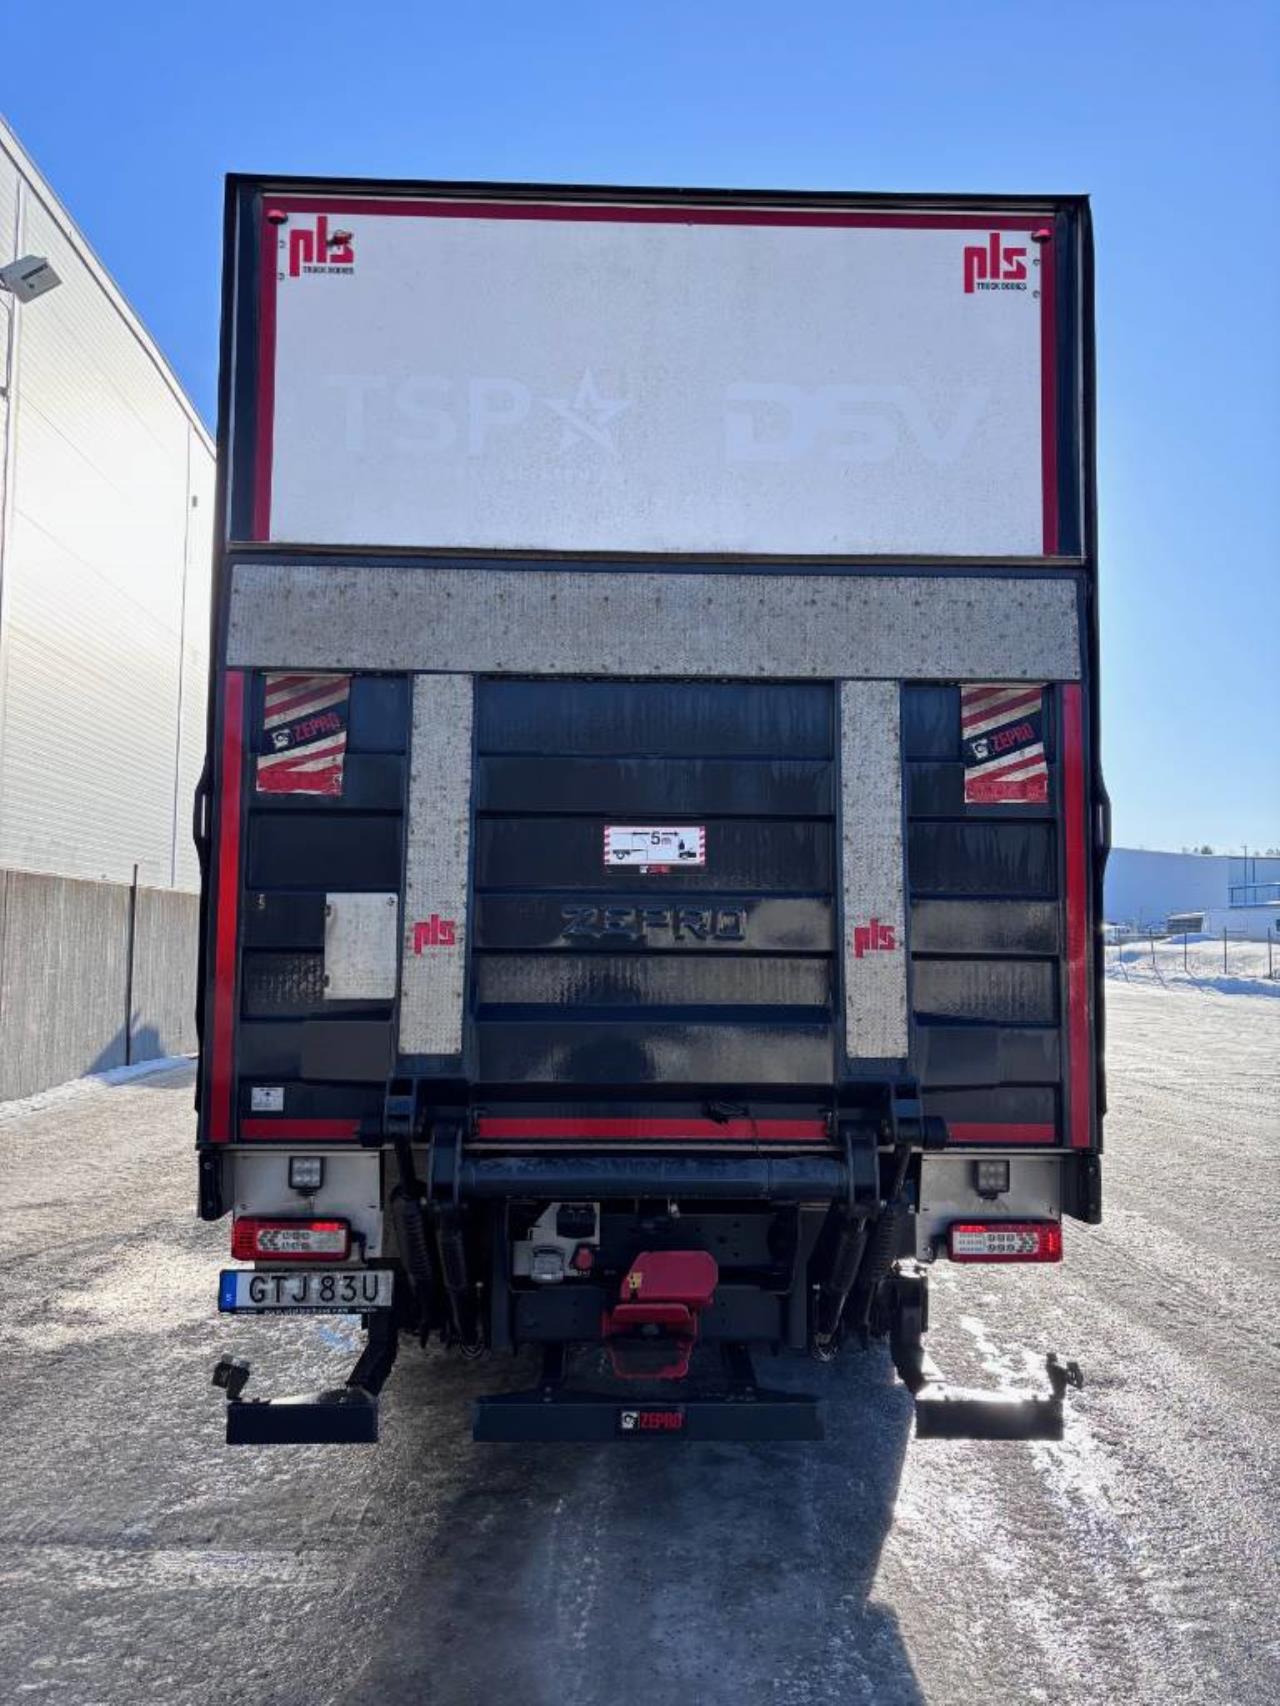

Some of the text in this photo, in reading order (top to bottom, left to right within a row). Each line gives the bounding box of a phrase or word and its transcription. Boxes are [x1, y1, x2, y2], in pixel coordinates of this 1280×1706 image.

[964, 232, 1027, 294] pls
[328, 374, 531, 456] TSP
[726, 381, 991, 463] DSV
[295, 711, 341, 742] ZEPRO
[990, 722, 1035, 752] ZEPRO
[414, 914, 456, 954] pls
[561, 905, 747, 941] ZEPRO
[855, 918, 895, 958] pls
[249, 1275, 379, 1303] GTJ 83U
[640, 1412, 683, 1428] ZEPRO
